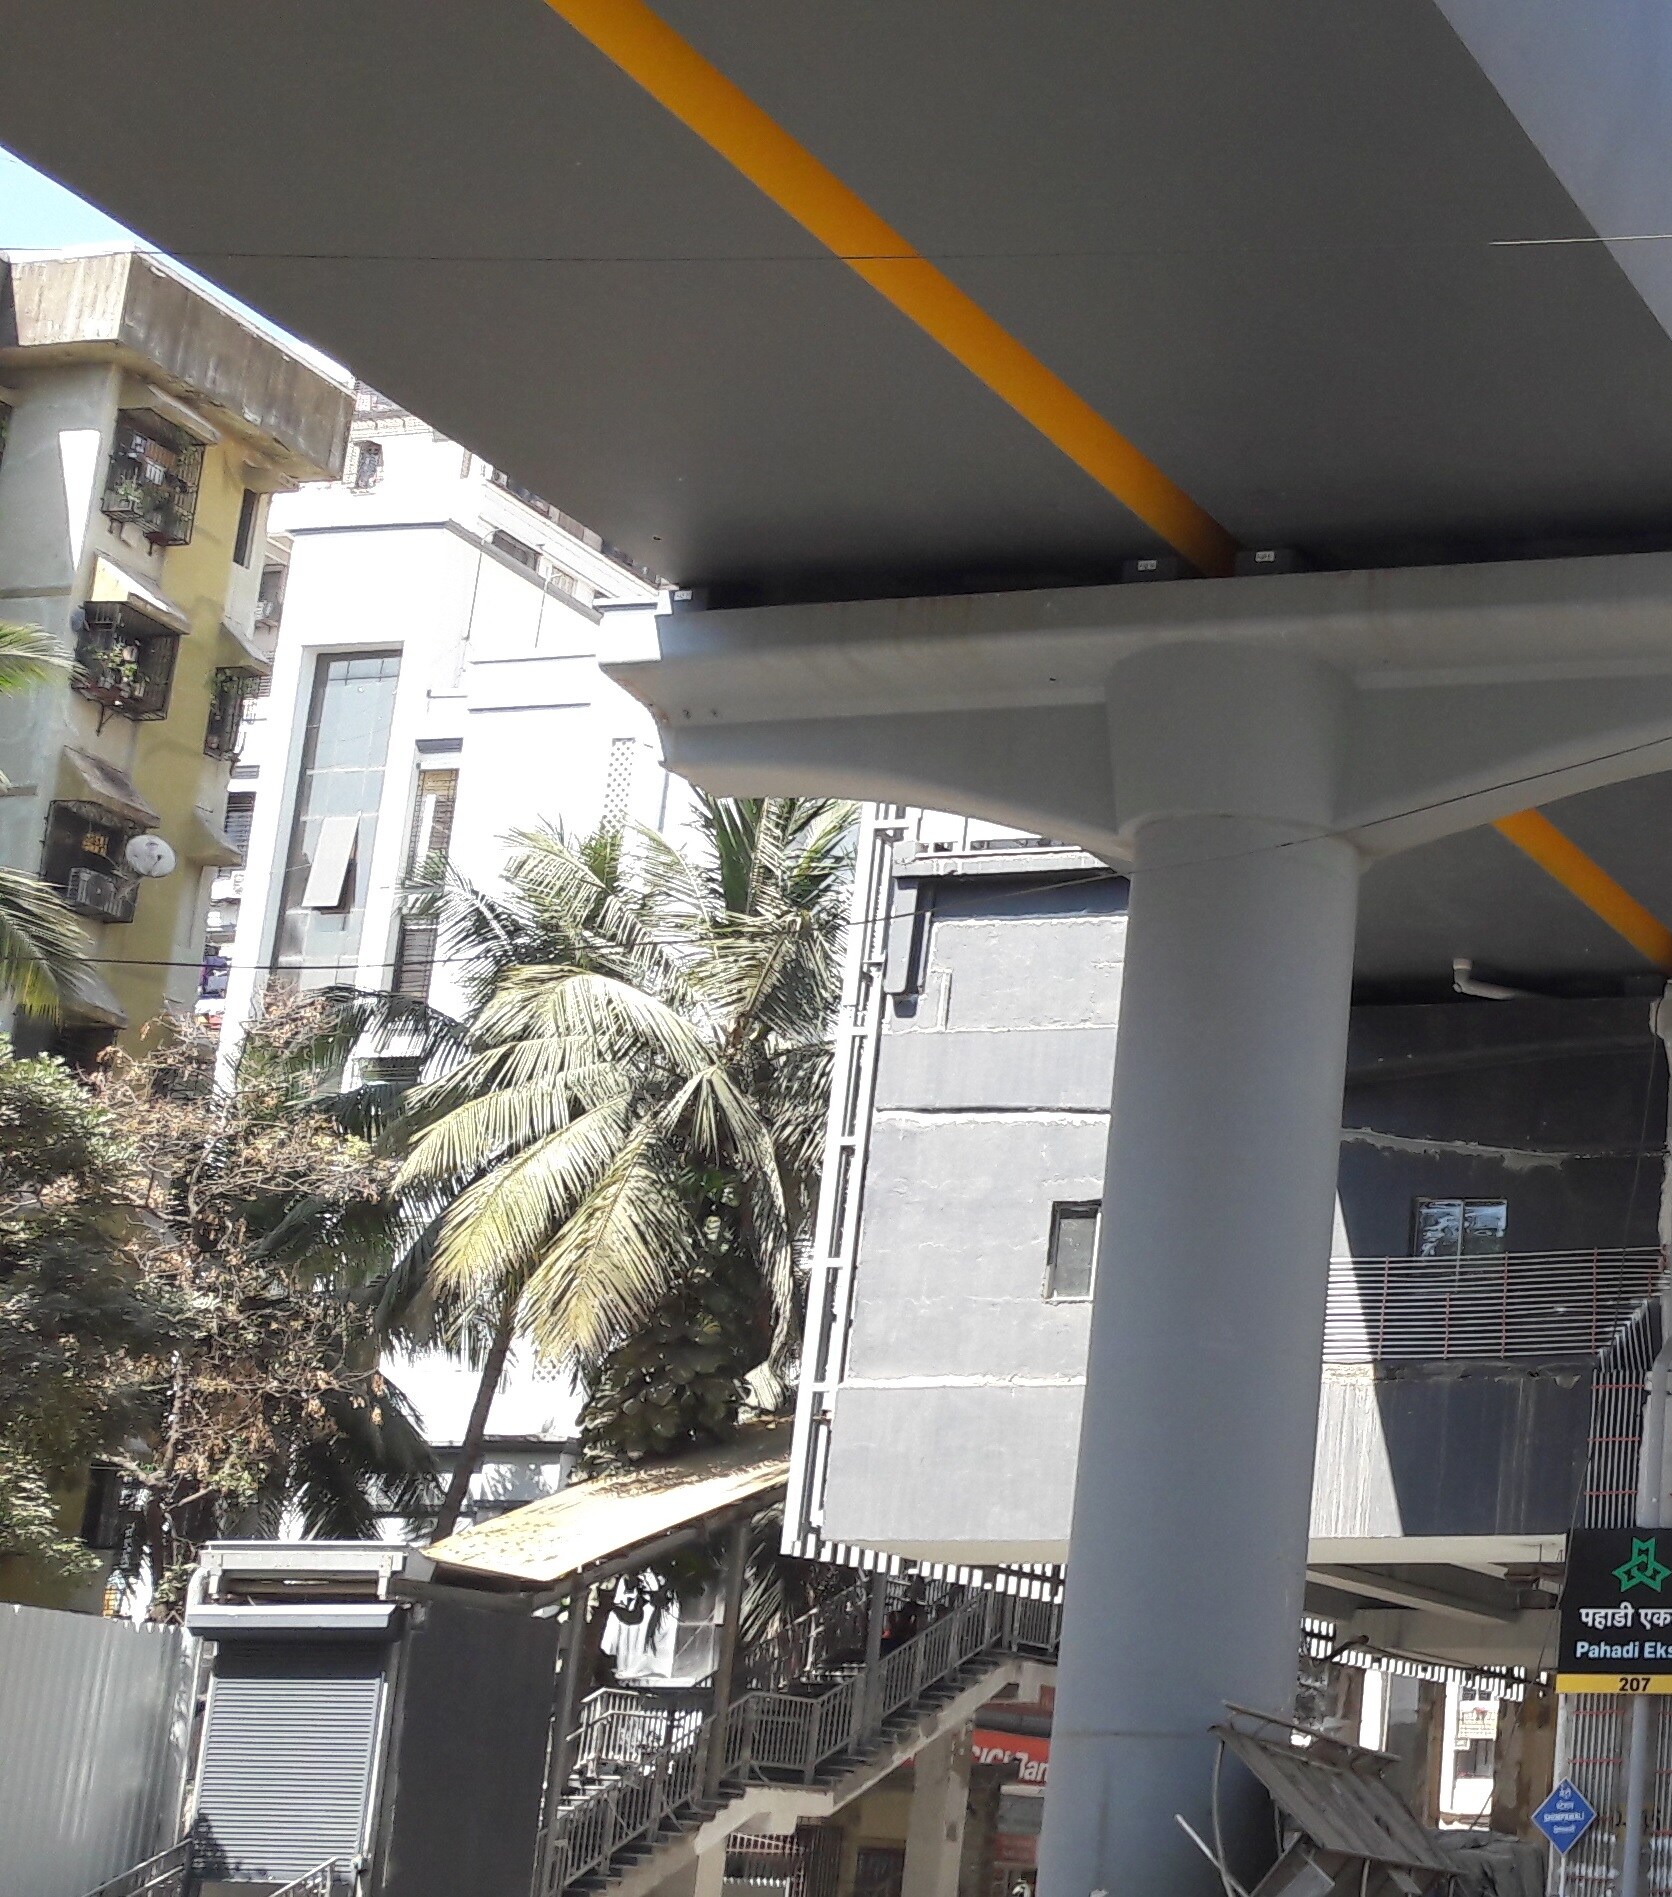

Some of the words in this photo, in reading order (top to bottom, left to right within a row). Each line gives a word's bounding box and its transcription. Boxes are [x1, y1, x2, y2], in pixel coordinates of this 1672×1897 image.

[1579, 1601, 1634, 1630] पहाडी
[1575, 1641, 1639, 1659] Pahadi
[1618, 1677, 1651, 1692] 207
